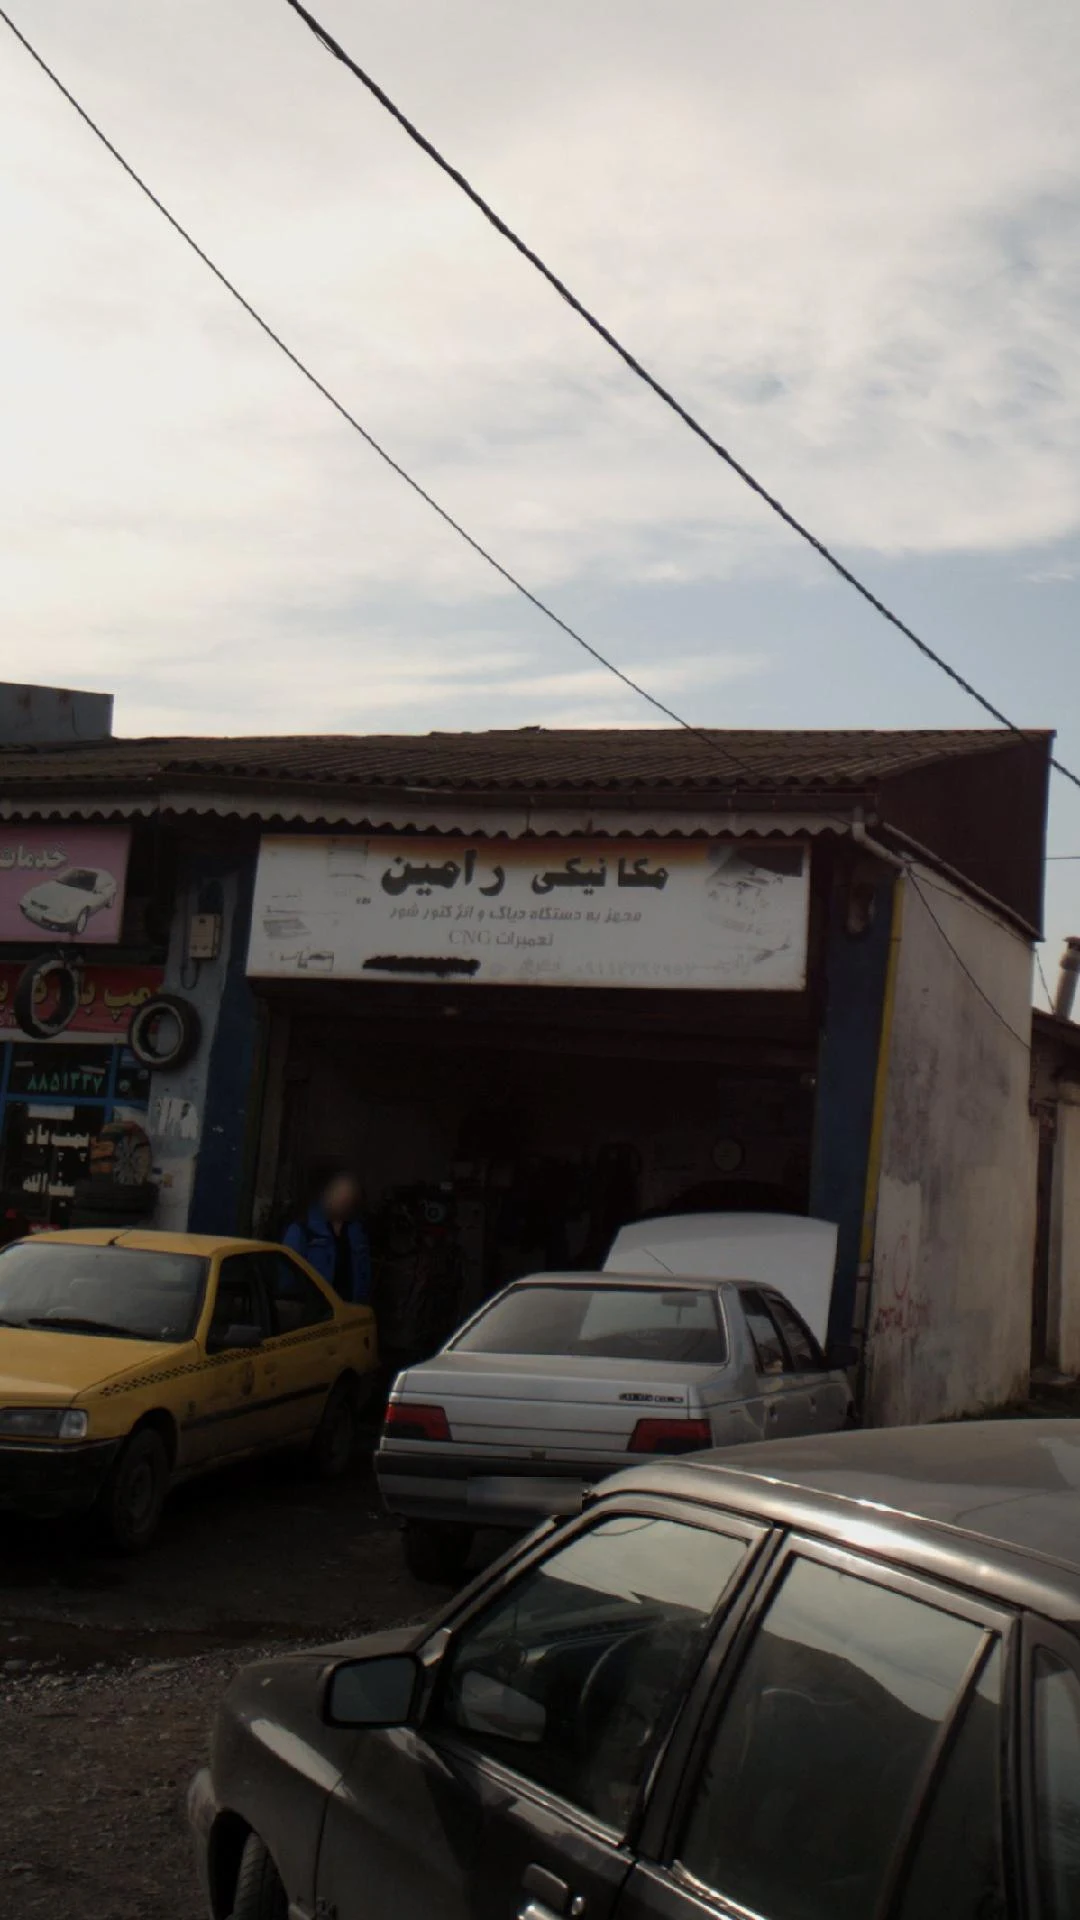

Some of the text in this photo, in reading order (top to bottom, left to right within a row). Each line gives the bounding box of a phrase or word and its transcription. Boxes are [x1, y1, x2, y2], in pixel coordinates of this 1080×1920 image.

[381, 848, 669, 897] مکانیکی رامین
[389, 903, 418, 921] شور
[477, 910, 484, 923] و
[528, 907, 580, 921] دستگاه
[585, 910, 600, 923] به
[447, 929, 553, 950] تعمیرات CNG
